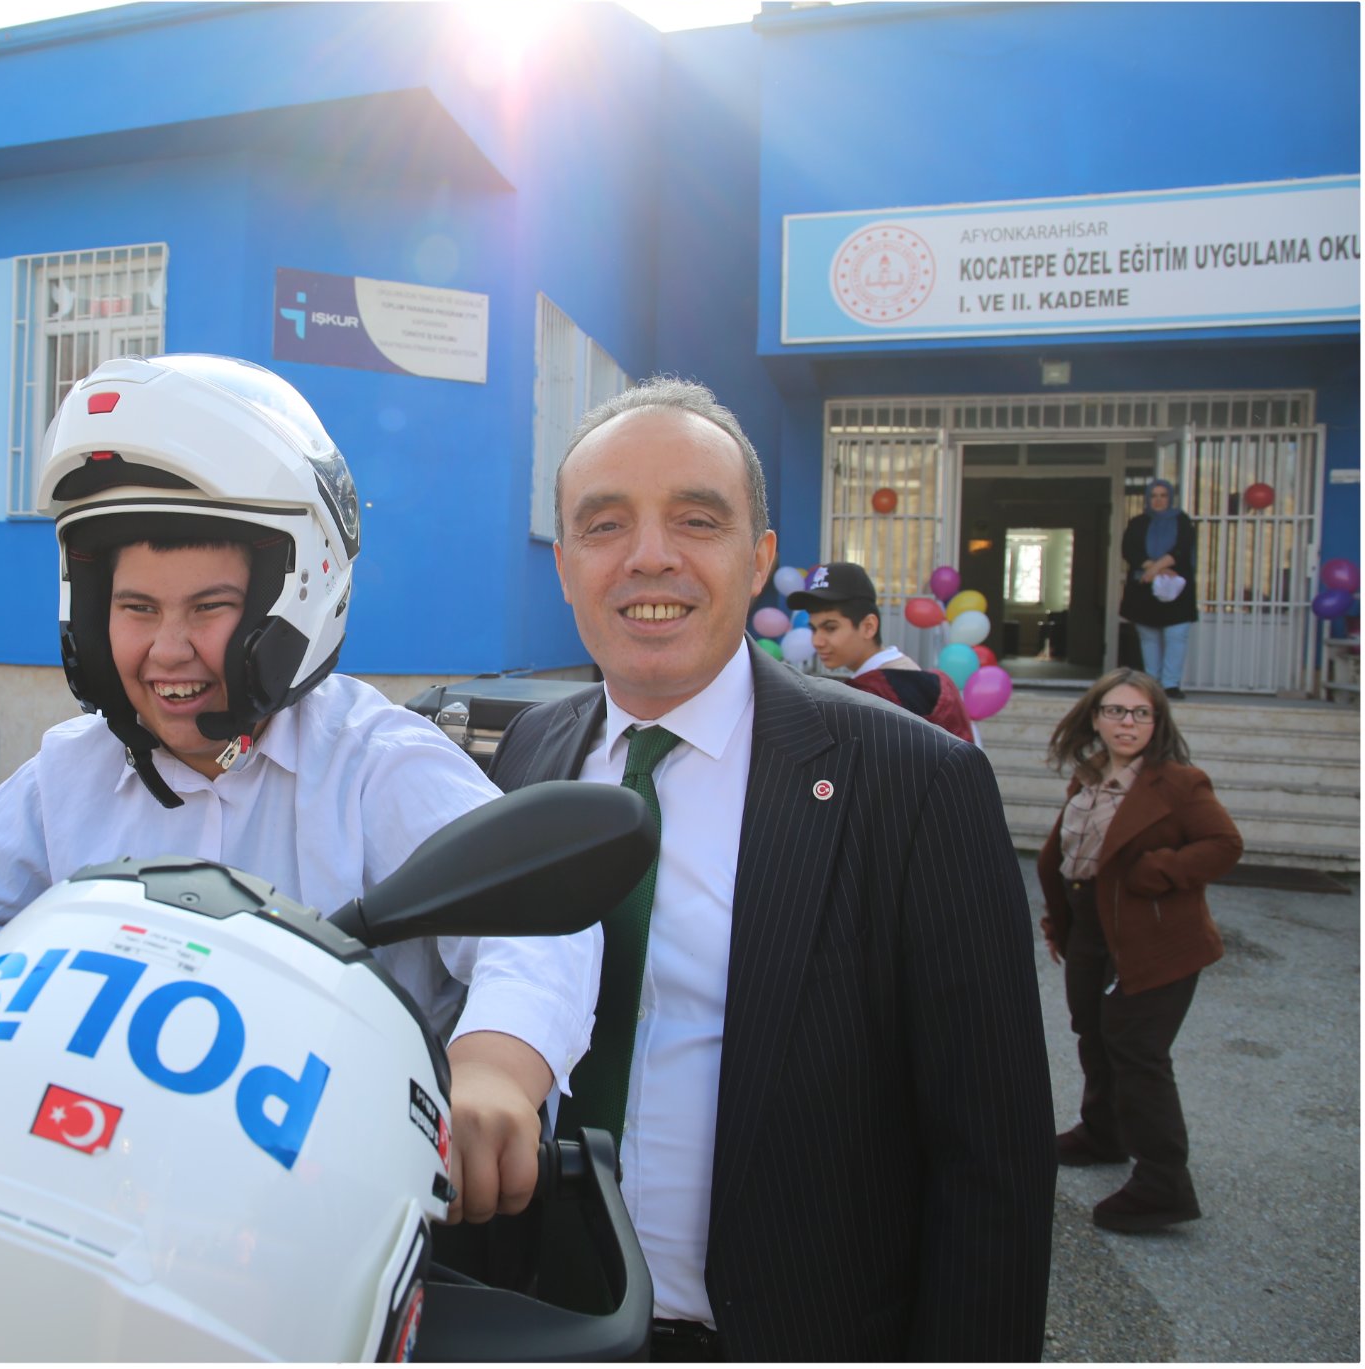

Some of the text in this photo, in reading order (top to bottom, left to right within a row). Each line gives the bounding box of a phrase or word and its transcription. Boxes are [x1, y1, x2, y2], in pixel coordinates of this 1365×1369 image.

[959, 253, 1057, 282] KOCATEPE
[1063, 248, 1113, 277] ÖZEL
[1119, 241, 1188, 274] EĞİTİM
[1195, 237, 1312, 270] UYGULAMA
[978, 294, 1005, 313] VE
[1039, 288, 1130, 310] KADEME
